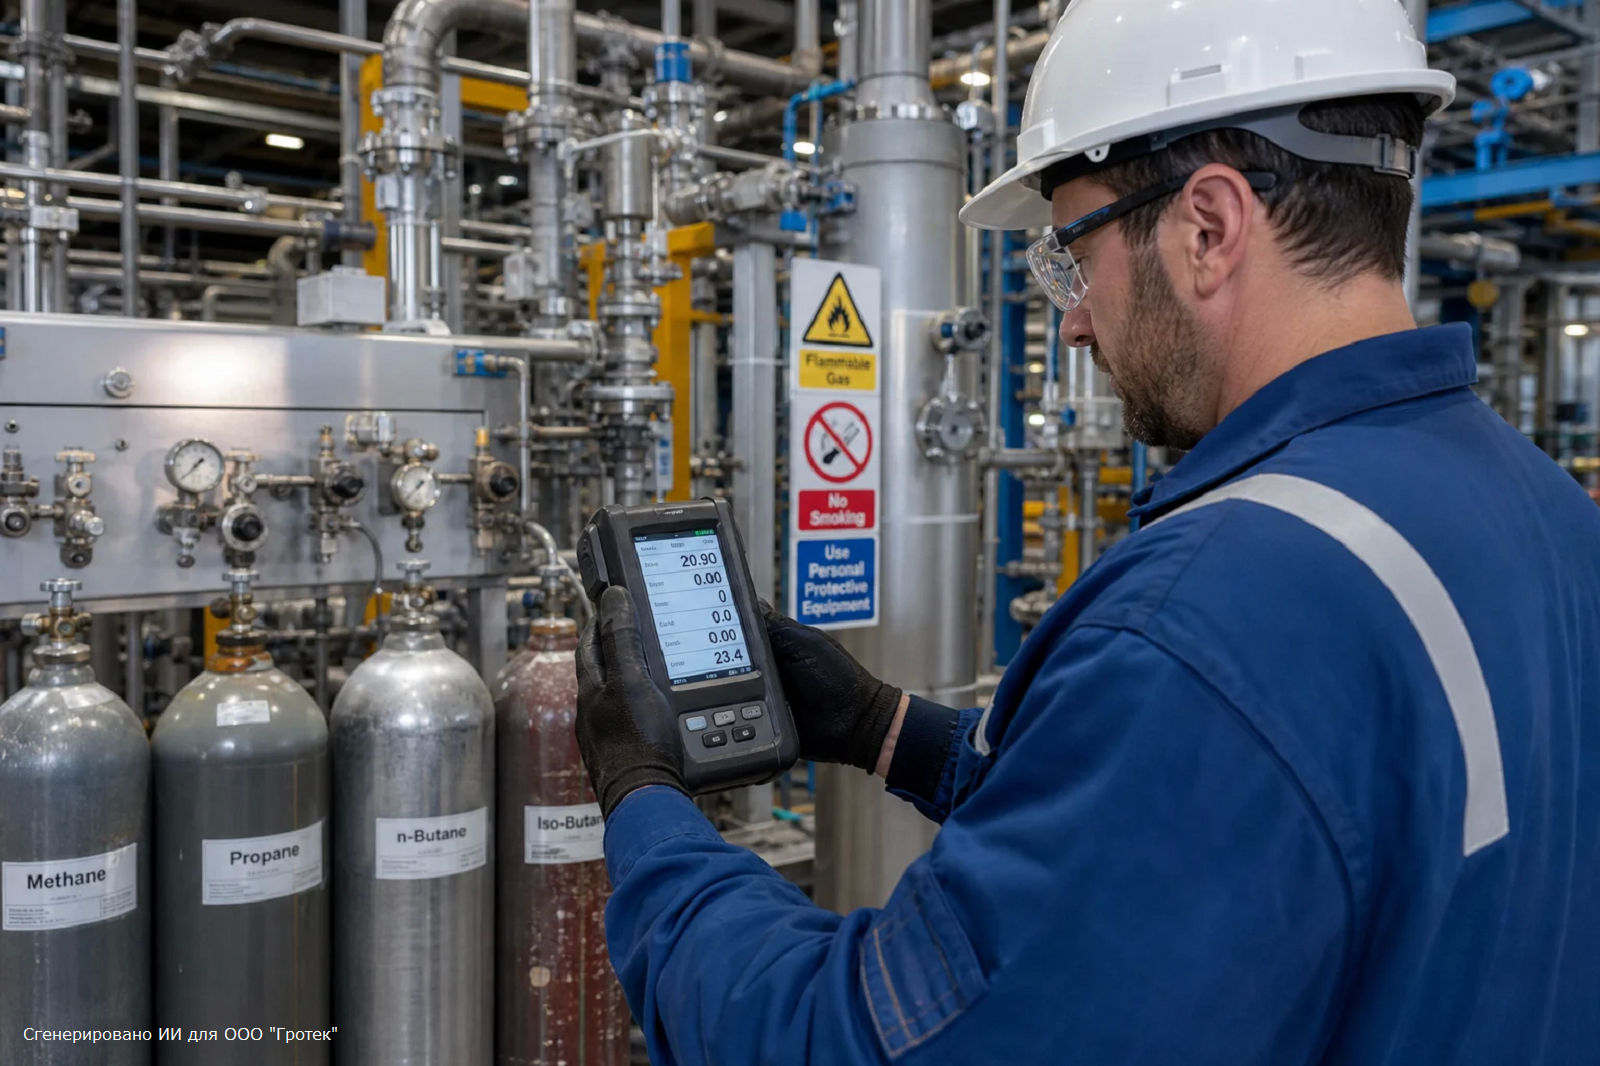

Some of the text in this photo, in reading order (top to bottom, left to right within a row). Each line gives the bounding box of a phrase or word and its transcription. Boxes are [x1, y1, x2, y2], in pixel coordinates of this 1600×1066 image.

[805, 353, 870, 371] Flammable
[826, 371, 850, 386] Gas
[828, 492, 848, 508] No
[809, 509, 865, 528] Smoking
[680, 552, 718, 568] 20.90
[824, 544, 850, 560] Use
[808, 561, 865, 578] Personal
[693, 571, 723, 586] 0.00
[718, 589, 727, 603] 0
[804, 580, 868, 598] Protective
[801, 598, 870, 617] Equipment
[712, 609, 732, 624] 0.0
[708, 628, 737, 644] 0.00
[714, 648, 743, 665] 23.4
[537, 814, 604, 831] Iso-Butan
[397, 827, 467, 843] n-Butane
[230, 844, 300, 866] Propane
[27, 869, 106, 890] Methane
